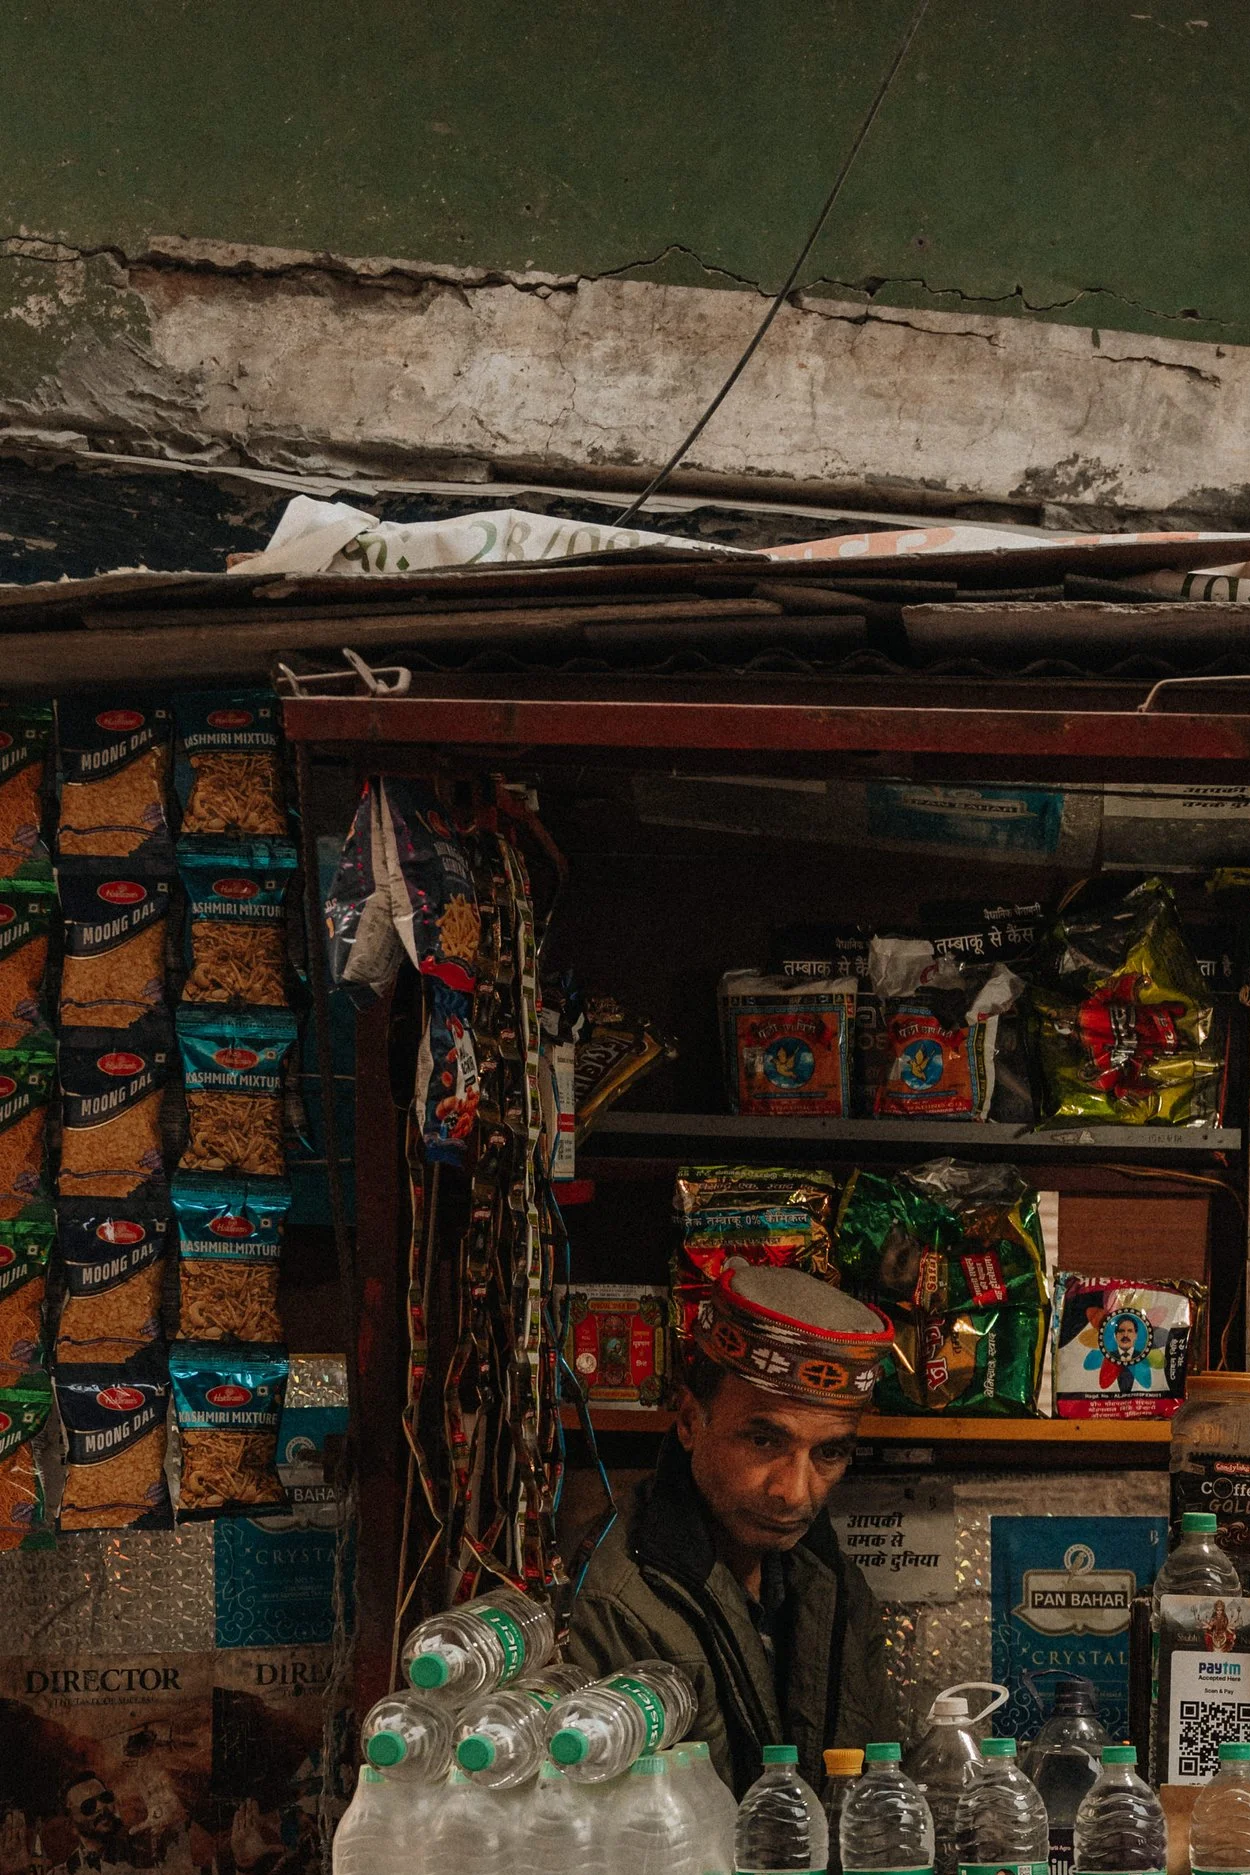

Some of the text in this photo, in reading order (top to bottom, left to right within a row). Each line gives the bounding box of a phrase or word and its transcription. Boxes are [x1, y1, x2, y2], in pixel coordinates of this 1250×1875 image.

[81, 728, 153, 771] MOONG DAL
[83, 901, 156, 945] MOONG DAL
[934, 933, 985, 955] तम्बाकू
[988, 926, 1002, 948] से
[239, 1074, 282, 1089] MIXTUR
[81, 1072, 153, 1117] MOONG DAL
[82, 1242, 155, 1285] MOONG DAL
[178, 1411, 278, 1425] KASHMIRI MIXTURE
[85, 1407, 156, 1452] MOONG DAL
[294, 1487, 342, 1502] BAHA
[847, 1511, 904, 1528] आपकी
[891, 1531, 905, 1547] से
[889, 1551, 940, 1571] दुनिया
[1034, 1593, 1126, 1608] PAN BAHAR
[1032, 1651, 1128, 1665] CRYSTAL
[1198, 1662, 1241, 1675] paytm
[25, 1667, 182, 1694] DIRECTOR
